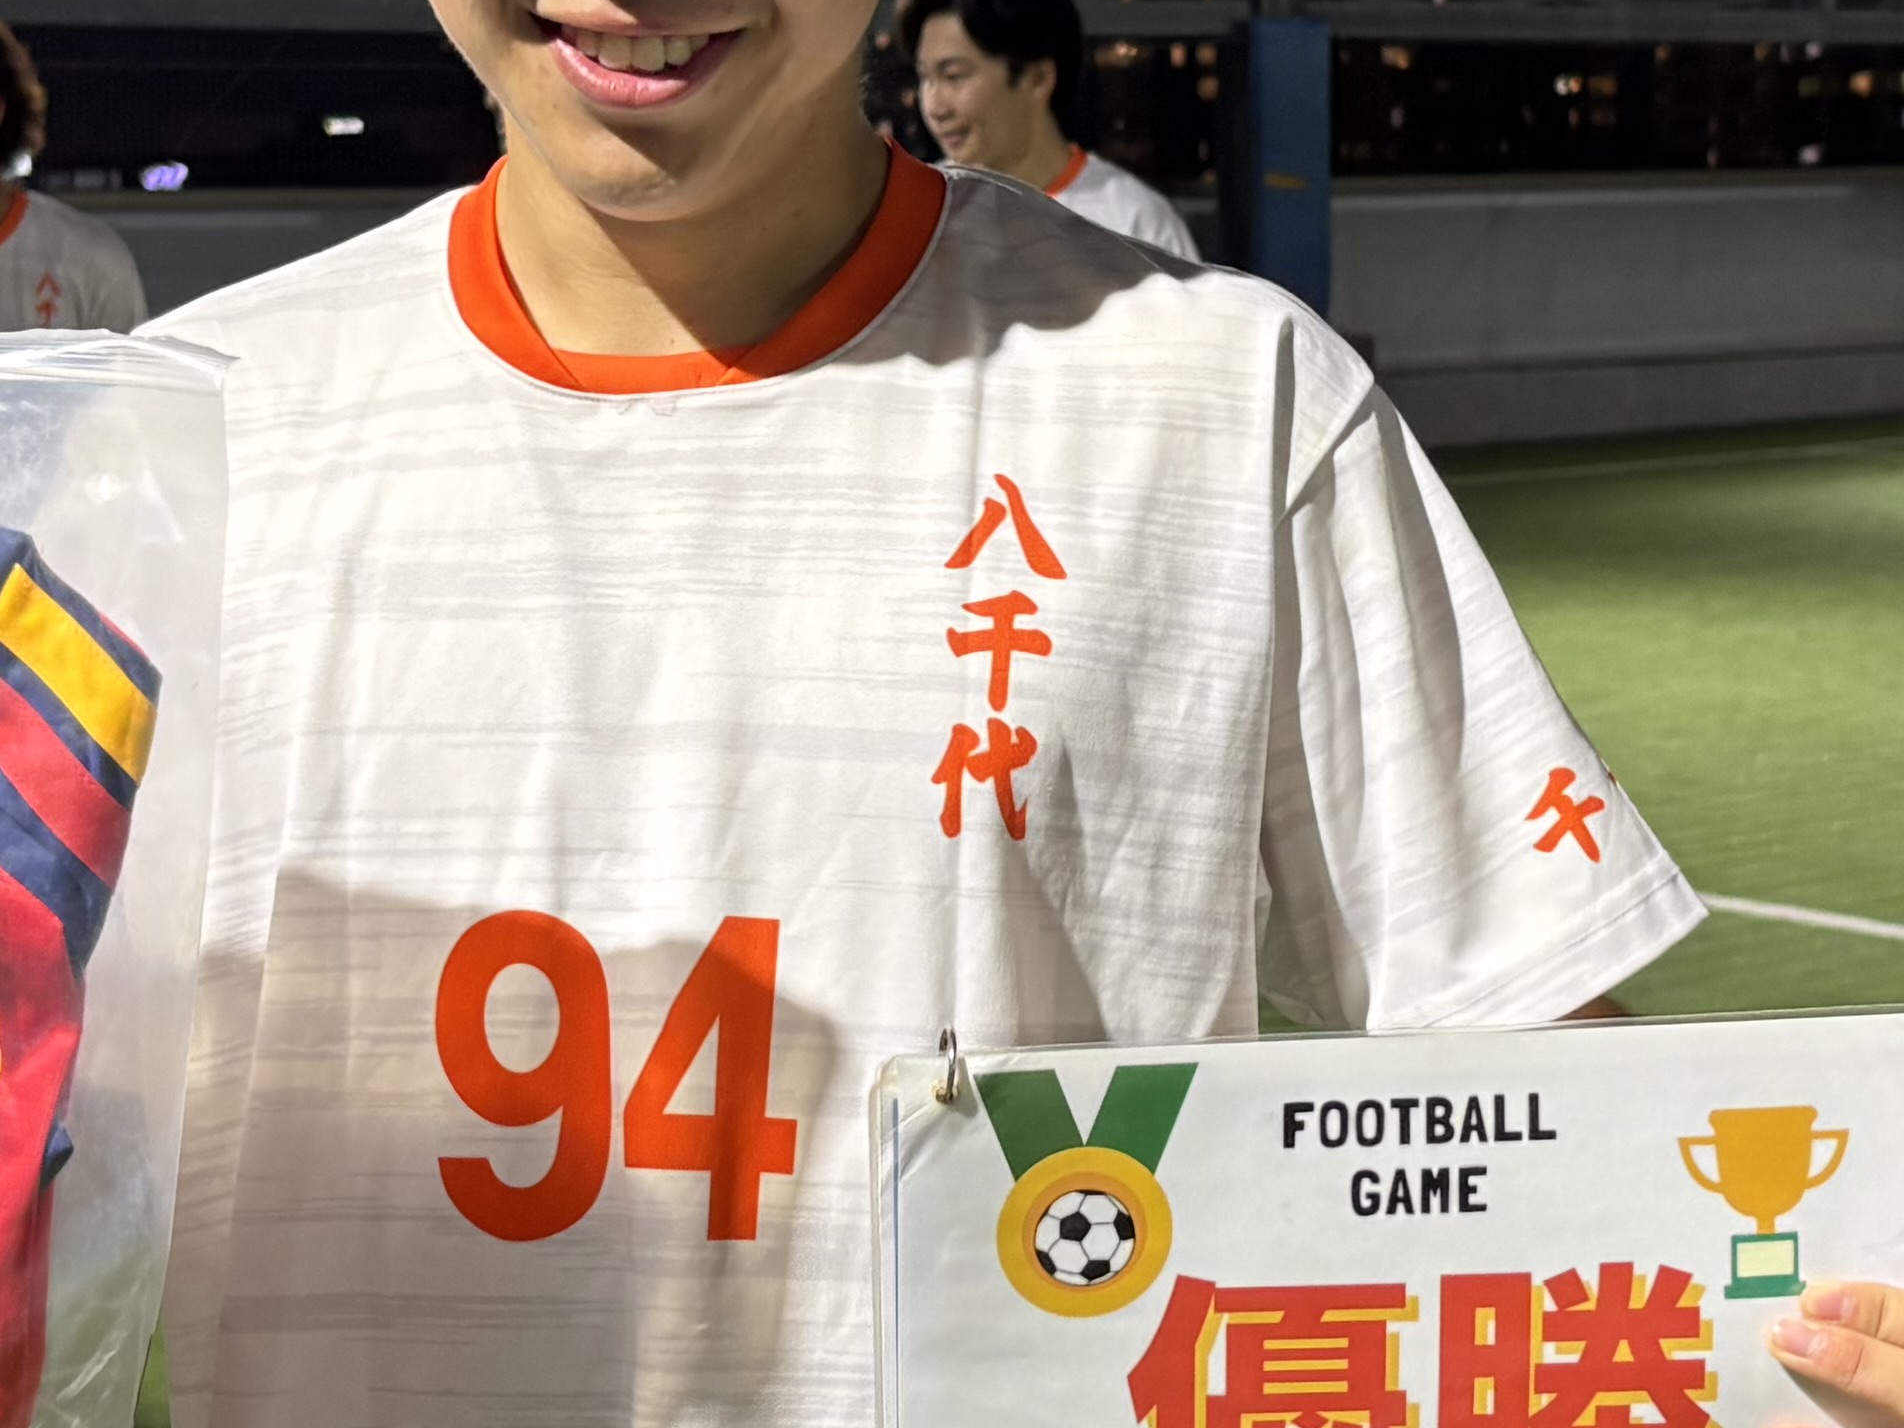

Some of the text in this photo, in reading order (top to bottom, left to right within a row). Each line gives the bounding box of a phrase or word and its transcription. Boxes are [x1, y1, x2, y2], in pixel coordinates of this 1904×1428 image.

[930, 473, 1067, 840] 八千代
[435, 909, 798, 1242] 94
[1282, 1092, 1557, 1151] FOOTBALL
[1349, 1166, 1490, 1218] GAME
